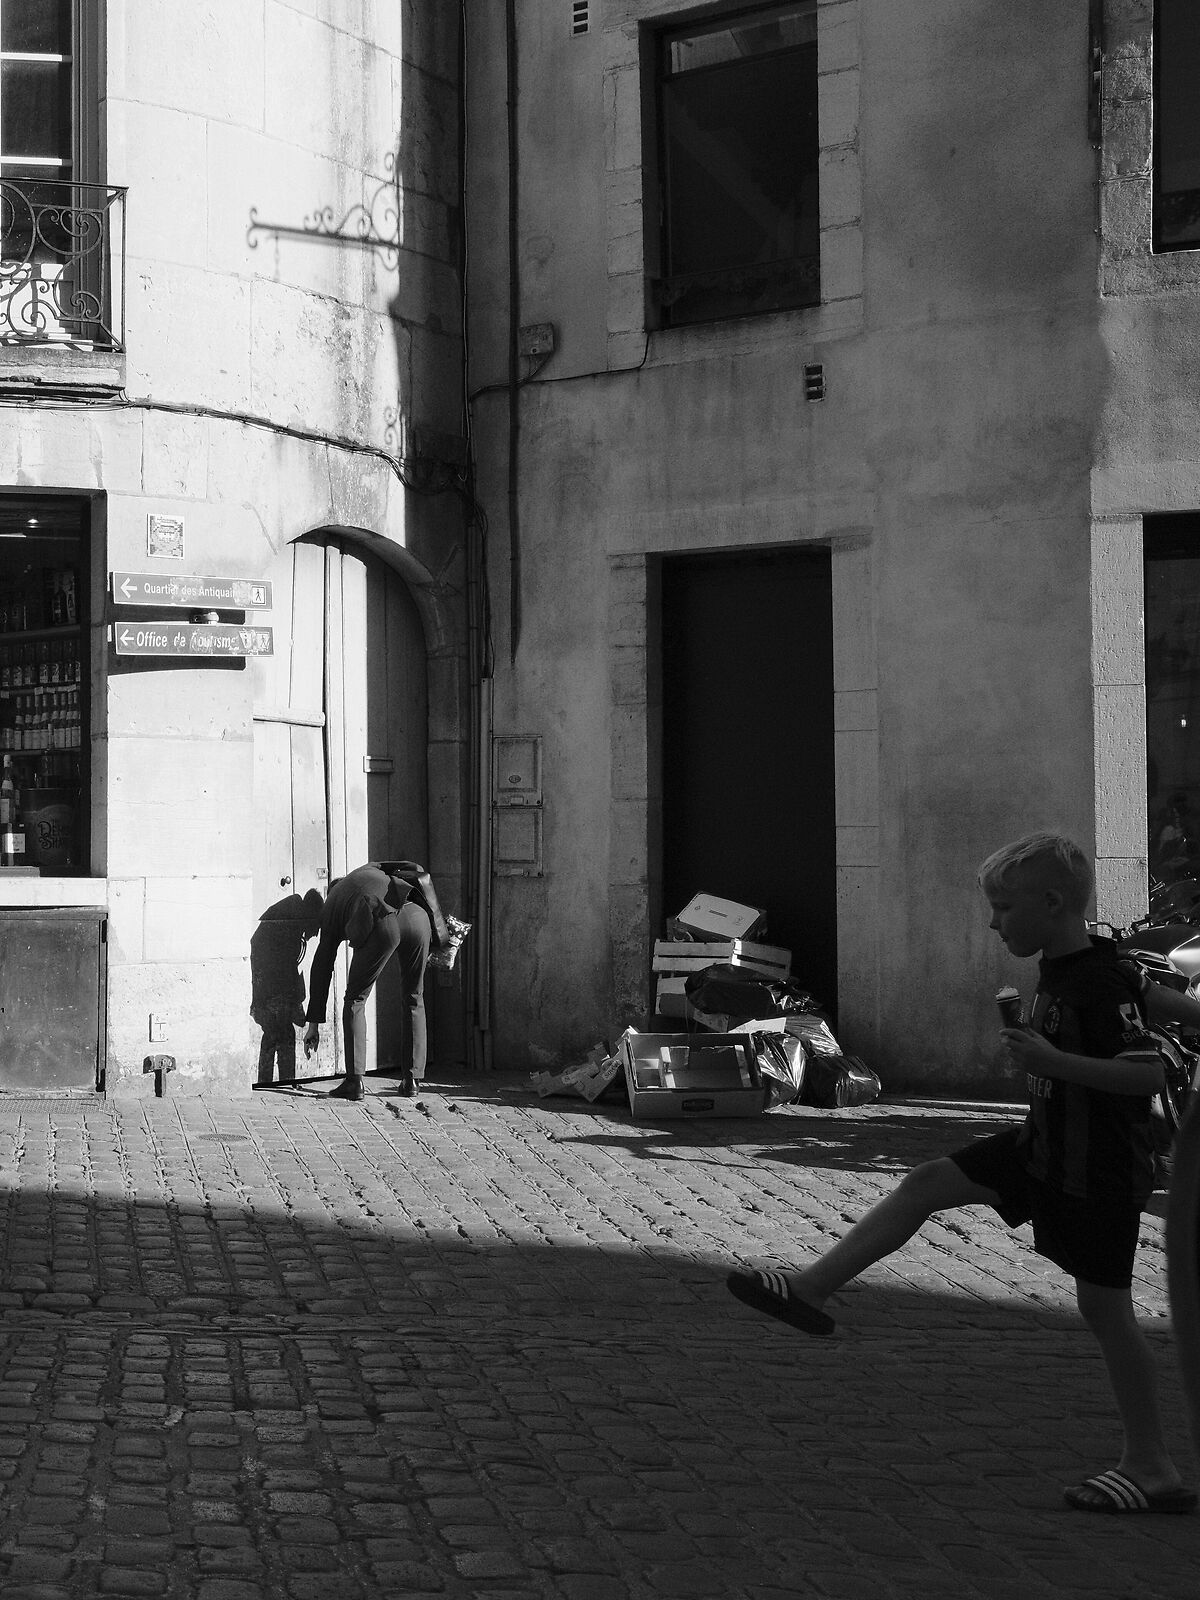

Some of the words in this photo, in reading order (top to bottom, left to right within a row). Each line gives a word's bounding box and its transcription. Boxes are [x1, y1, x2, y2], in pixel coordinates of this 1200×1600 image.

[181, 585, 197, 596] des
[136, 631, 168, 647] Office
[174, 631, 186, 647] de
